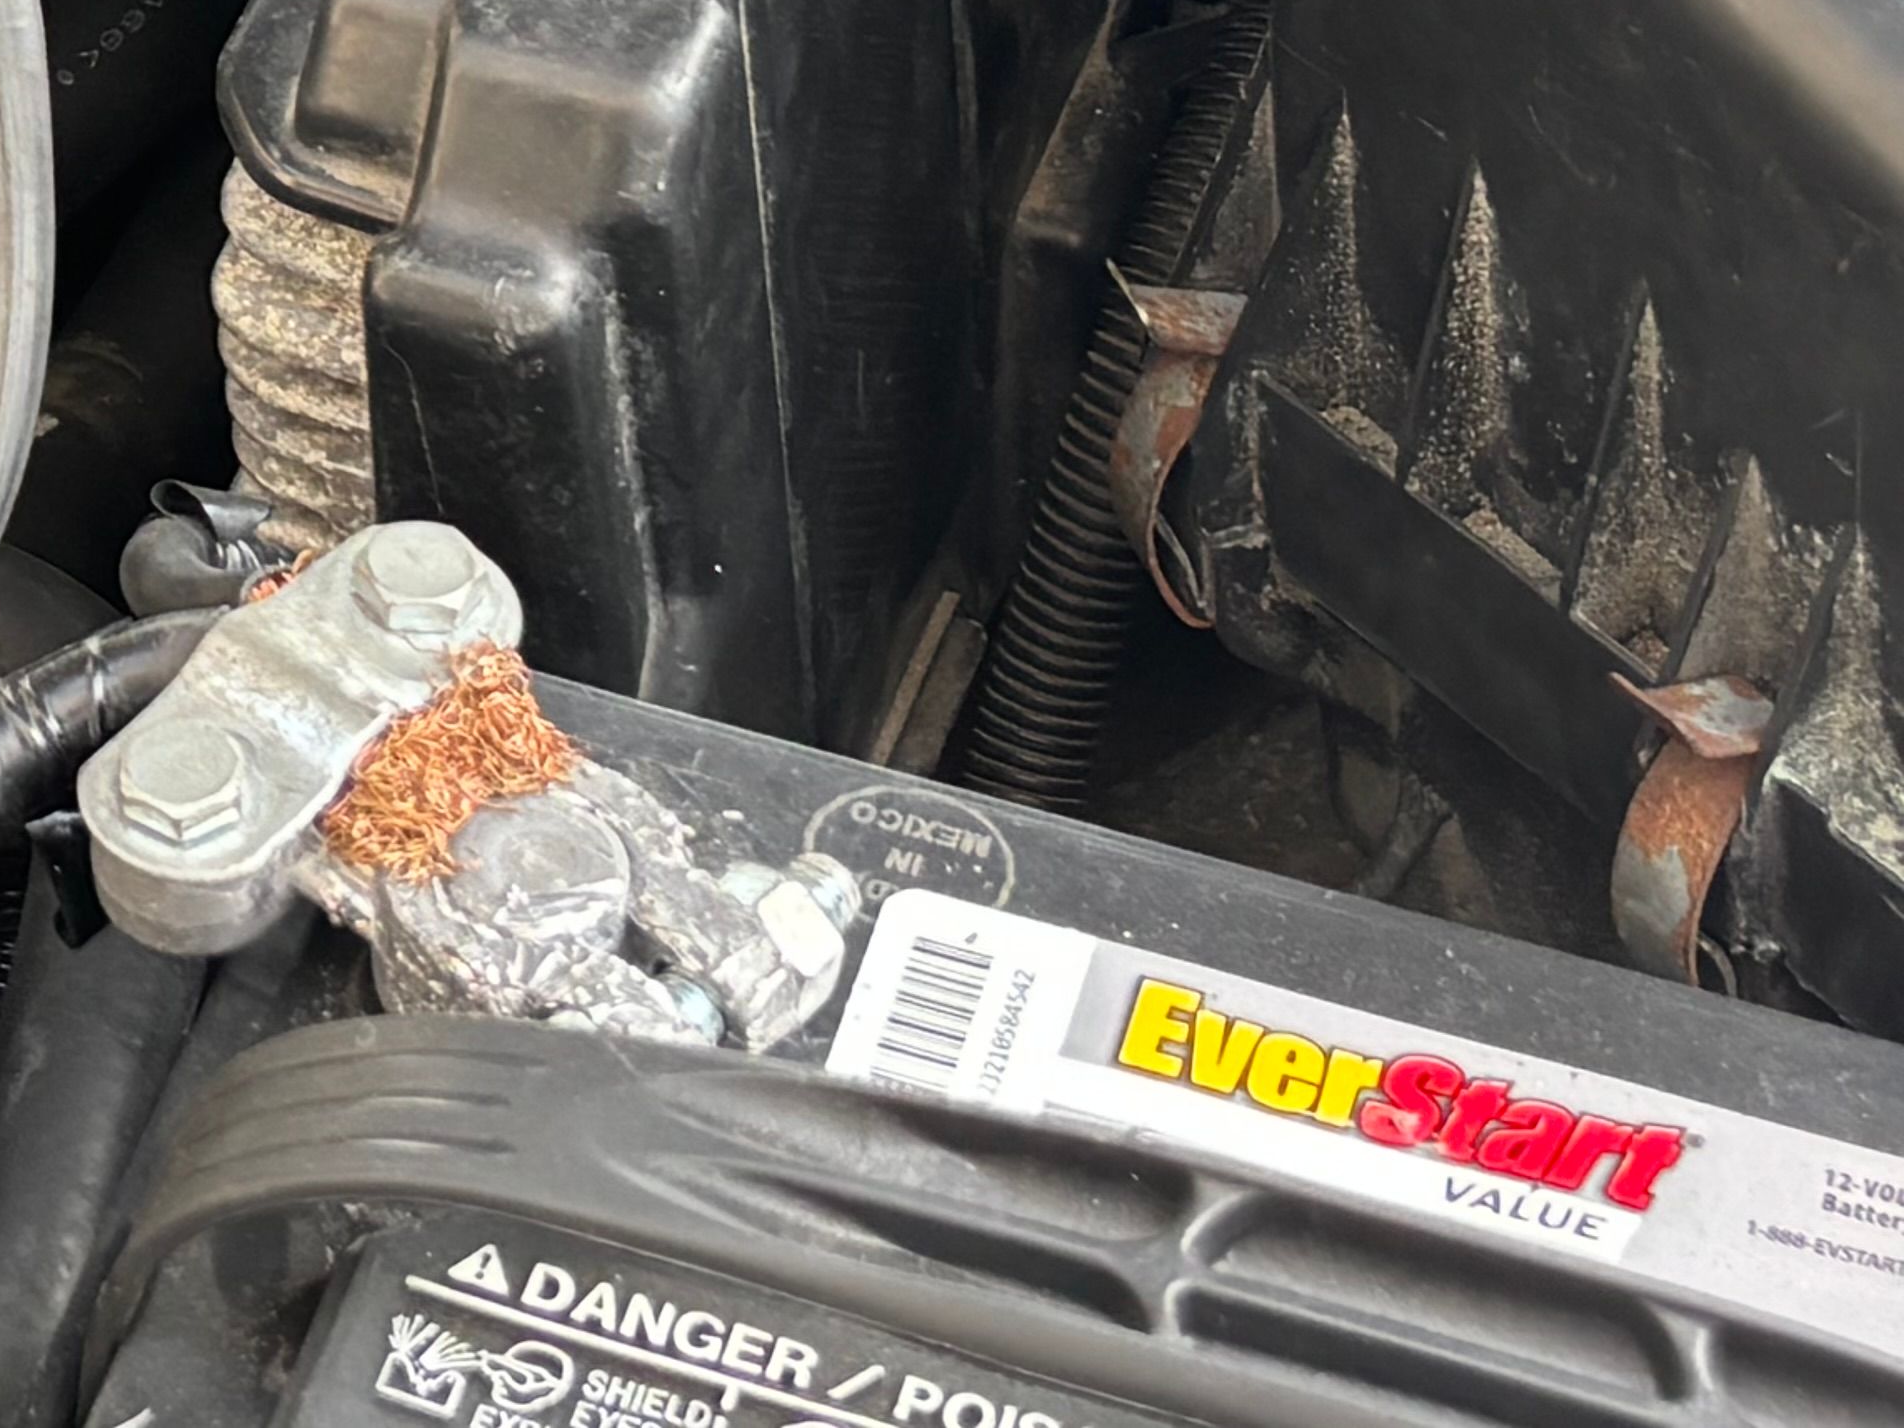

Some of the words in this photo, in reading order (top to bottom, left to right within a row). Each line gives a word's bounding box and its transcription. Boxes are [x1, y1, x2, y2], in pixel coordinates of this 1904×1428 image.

[850, 800, 993, 859] MEXICO
[884, 846, 926, 877] IN
[1117, 975, 1685, 1211] EverStart
[1445, 1175, 1607, 1241] VALUE
[522, 1261, 819, 1387] DANGER
[582, 1369, 713, 1426] SHIELD
